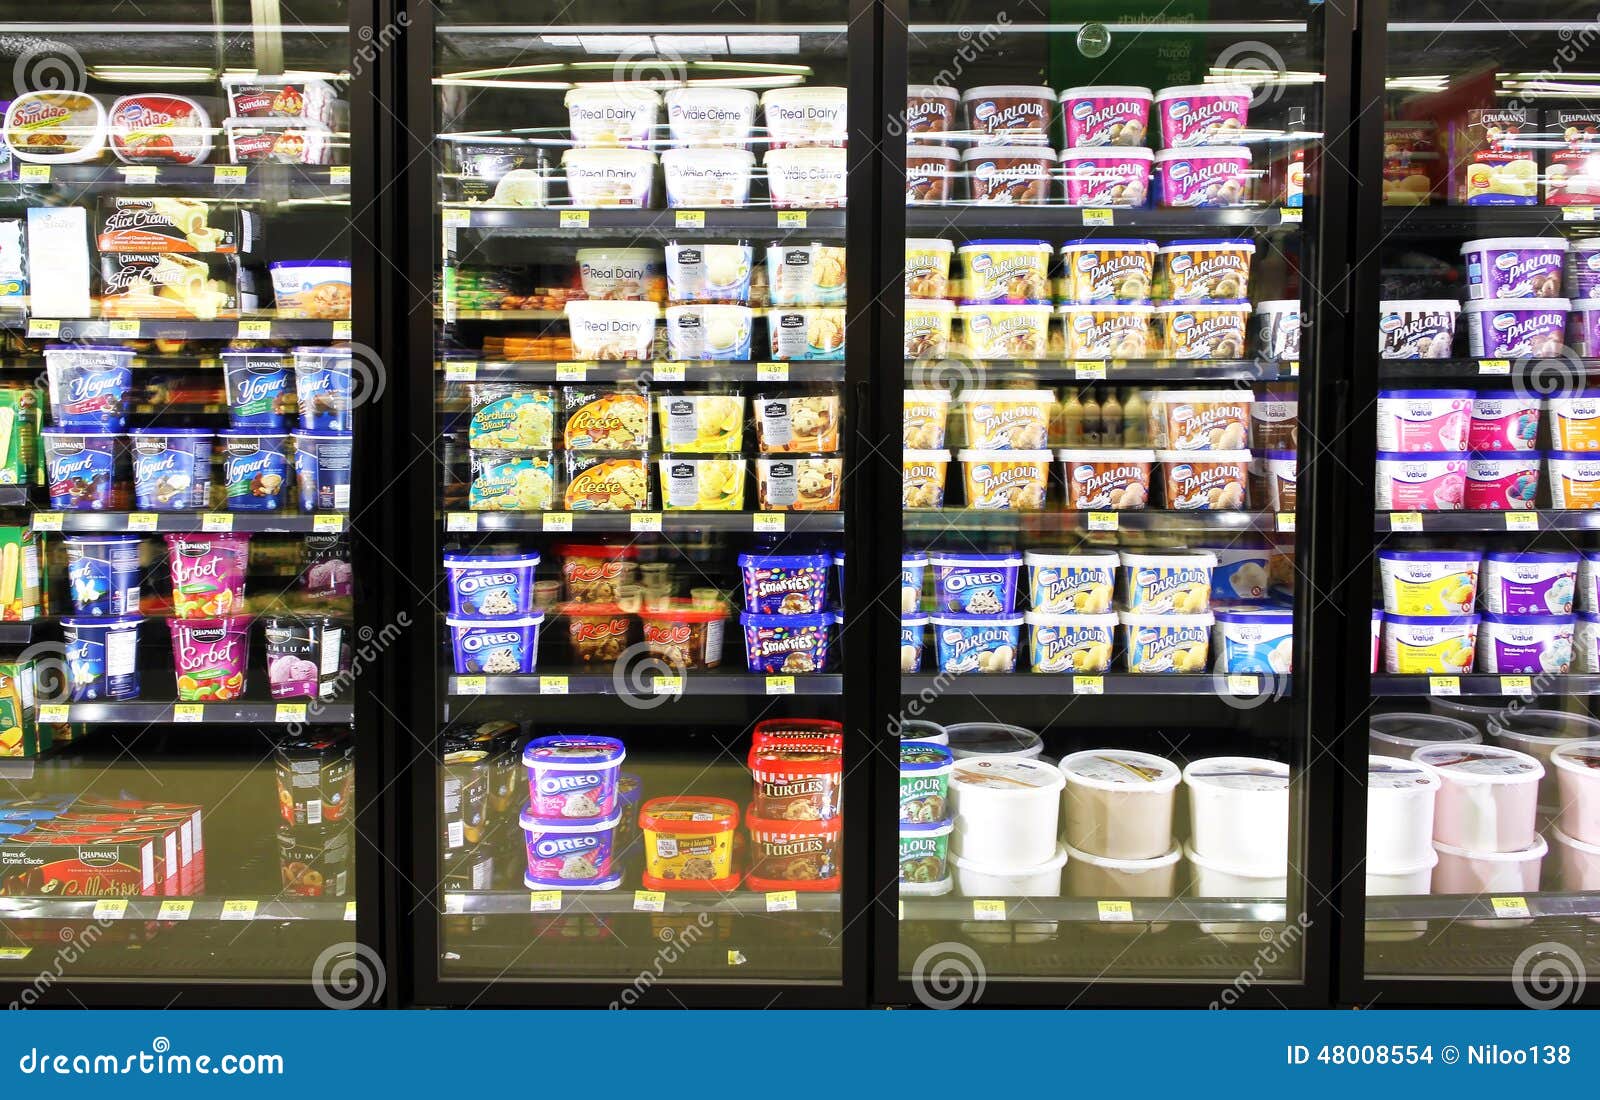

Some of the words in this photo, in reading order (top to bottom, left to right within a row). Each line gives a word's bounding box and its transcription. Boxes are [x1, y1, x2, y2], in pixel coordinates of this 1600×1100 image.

[238, 99, 271, 112] Sundae
[580, 108, 604, 120] Real
[606, 108, 637, 122] Dairy
[682, 109, 706, 120] Vraie
[707, 108, 741, 121] Crème
[780, 108, 805, 120] Real
[808, 108, 838, 121] Dairy
[907, 103, 946, 120] RLOUR
[13, 107, 67, 127] Sundae
[988, 103, 1044, 133] PARLOUR
[1086, 102, 1142, 132] PARLOUR
[1182, 101, 1240, 132] PARLOUR
[1482, 114, 1524, 123] CHAPMAN'S
[906, 163, 946, 181] RLOUR
[1182, 162, 1240, 193] PARLOUR
[104, 209, 133, 234] Slice
[134, 210, 178, 227] Cream
[121, 254, 160, 264] CHAPMAN'S
[984, 255, 1040, 279] PARLOUR
[1509, 254, 1561, 283] PARLOUR
[590, 267, 614, 279] Real
[616, 267, 644, 280] Dairy
[1089, 255, 1145, 284] PARLOUR
[1184, 255, 1242, 285] PARLOUR
[105, 266, 138, 294] Slice
[584, 320, 609, 332] Real
[612, 320, 641, 333] Dairy
[1086, 315, 1145, 345] PARLOUR
[1187, 315, 1241, 344] PARLOUR
[1393, 315, 1450, 346] PARLOUR
[1507, 313, 1562, 344] PARLOUR
[247, 361, 282, 369] CHAPMAN'S
[68, 372, 123, 402] Yogurt
[236, 374, 288, 404] Yogurt
[566, 393, 596, 409] Breyers
[475, 411, 517, 424] Birthday
[573, 411, 621, 429] Reese
[985, 406, 1041, 435] PARLOUR
[1185, 406, 1242, 435] PARLOUR
[227, 441, 258, 451] CHAPMAN'S
[50, 456, 93, 484] Yogurt
[134, 455, 175, 484] Yogurt
[224, 455, 272, 484] Yogourt
[475, 476, 517, 489] Birthday
[574, 476, 622, 494] Reese
[984, 466, 1040, 495] PARLOUR
[1086, 467, 1142, 496] PARLOUR
[1184, 466, 1240, 496] PARLOUR
[178, 540, 210, 551] CHAPMAN'S
[171, 556, 223, 584] Sorbet
[460, 574, 517, 593] OREO
[946, 573, 1003, 592] OREO
[1050, 571, 1106, 600] PARLOUR
[1149, 570, 1206, 600] PARLOUR
[192, 628, 226, 639] CHAPMAN'S
[464, 633, 520, 651] OREO
[266, 644, 310, 653] EMIUM
[955, 630, 1010, 658] PARLOUR
[1049, 629, 1105, 660] PARLOUR
[1149, 630, 1206, 658] PARLOUR
[180, 642, 238, 671] Sorbet
[541, 775, 599, 794] OREO
[764, 780, 823, 797] TURTLES
[900, 779, 940, 797] RLOUR
[80, 851, 118, 860] CHAPMAN'S
[538, 837, 597, 856] OREO
[764, 840, 823, 857] TURTLES
[2, 857, 23, 865] Crème
[23, 857, 44, 865] Glacée
[61, 875, 140, 895] Collection
